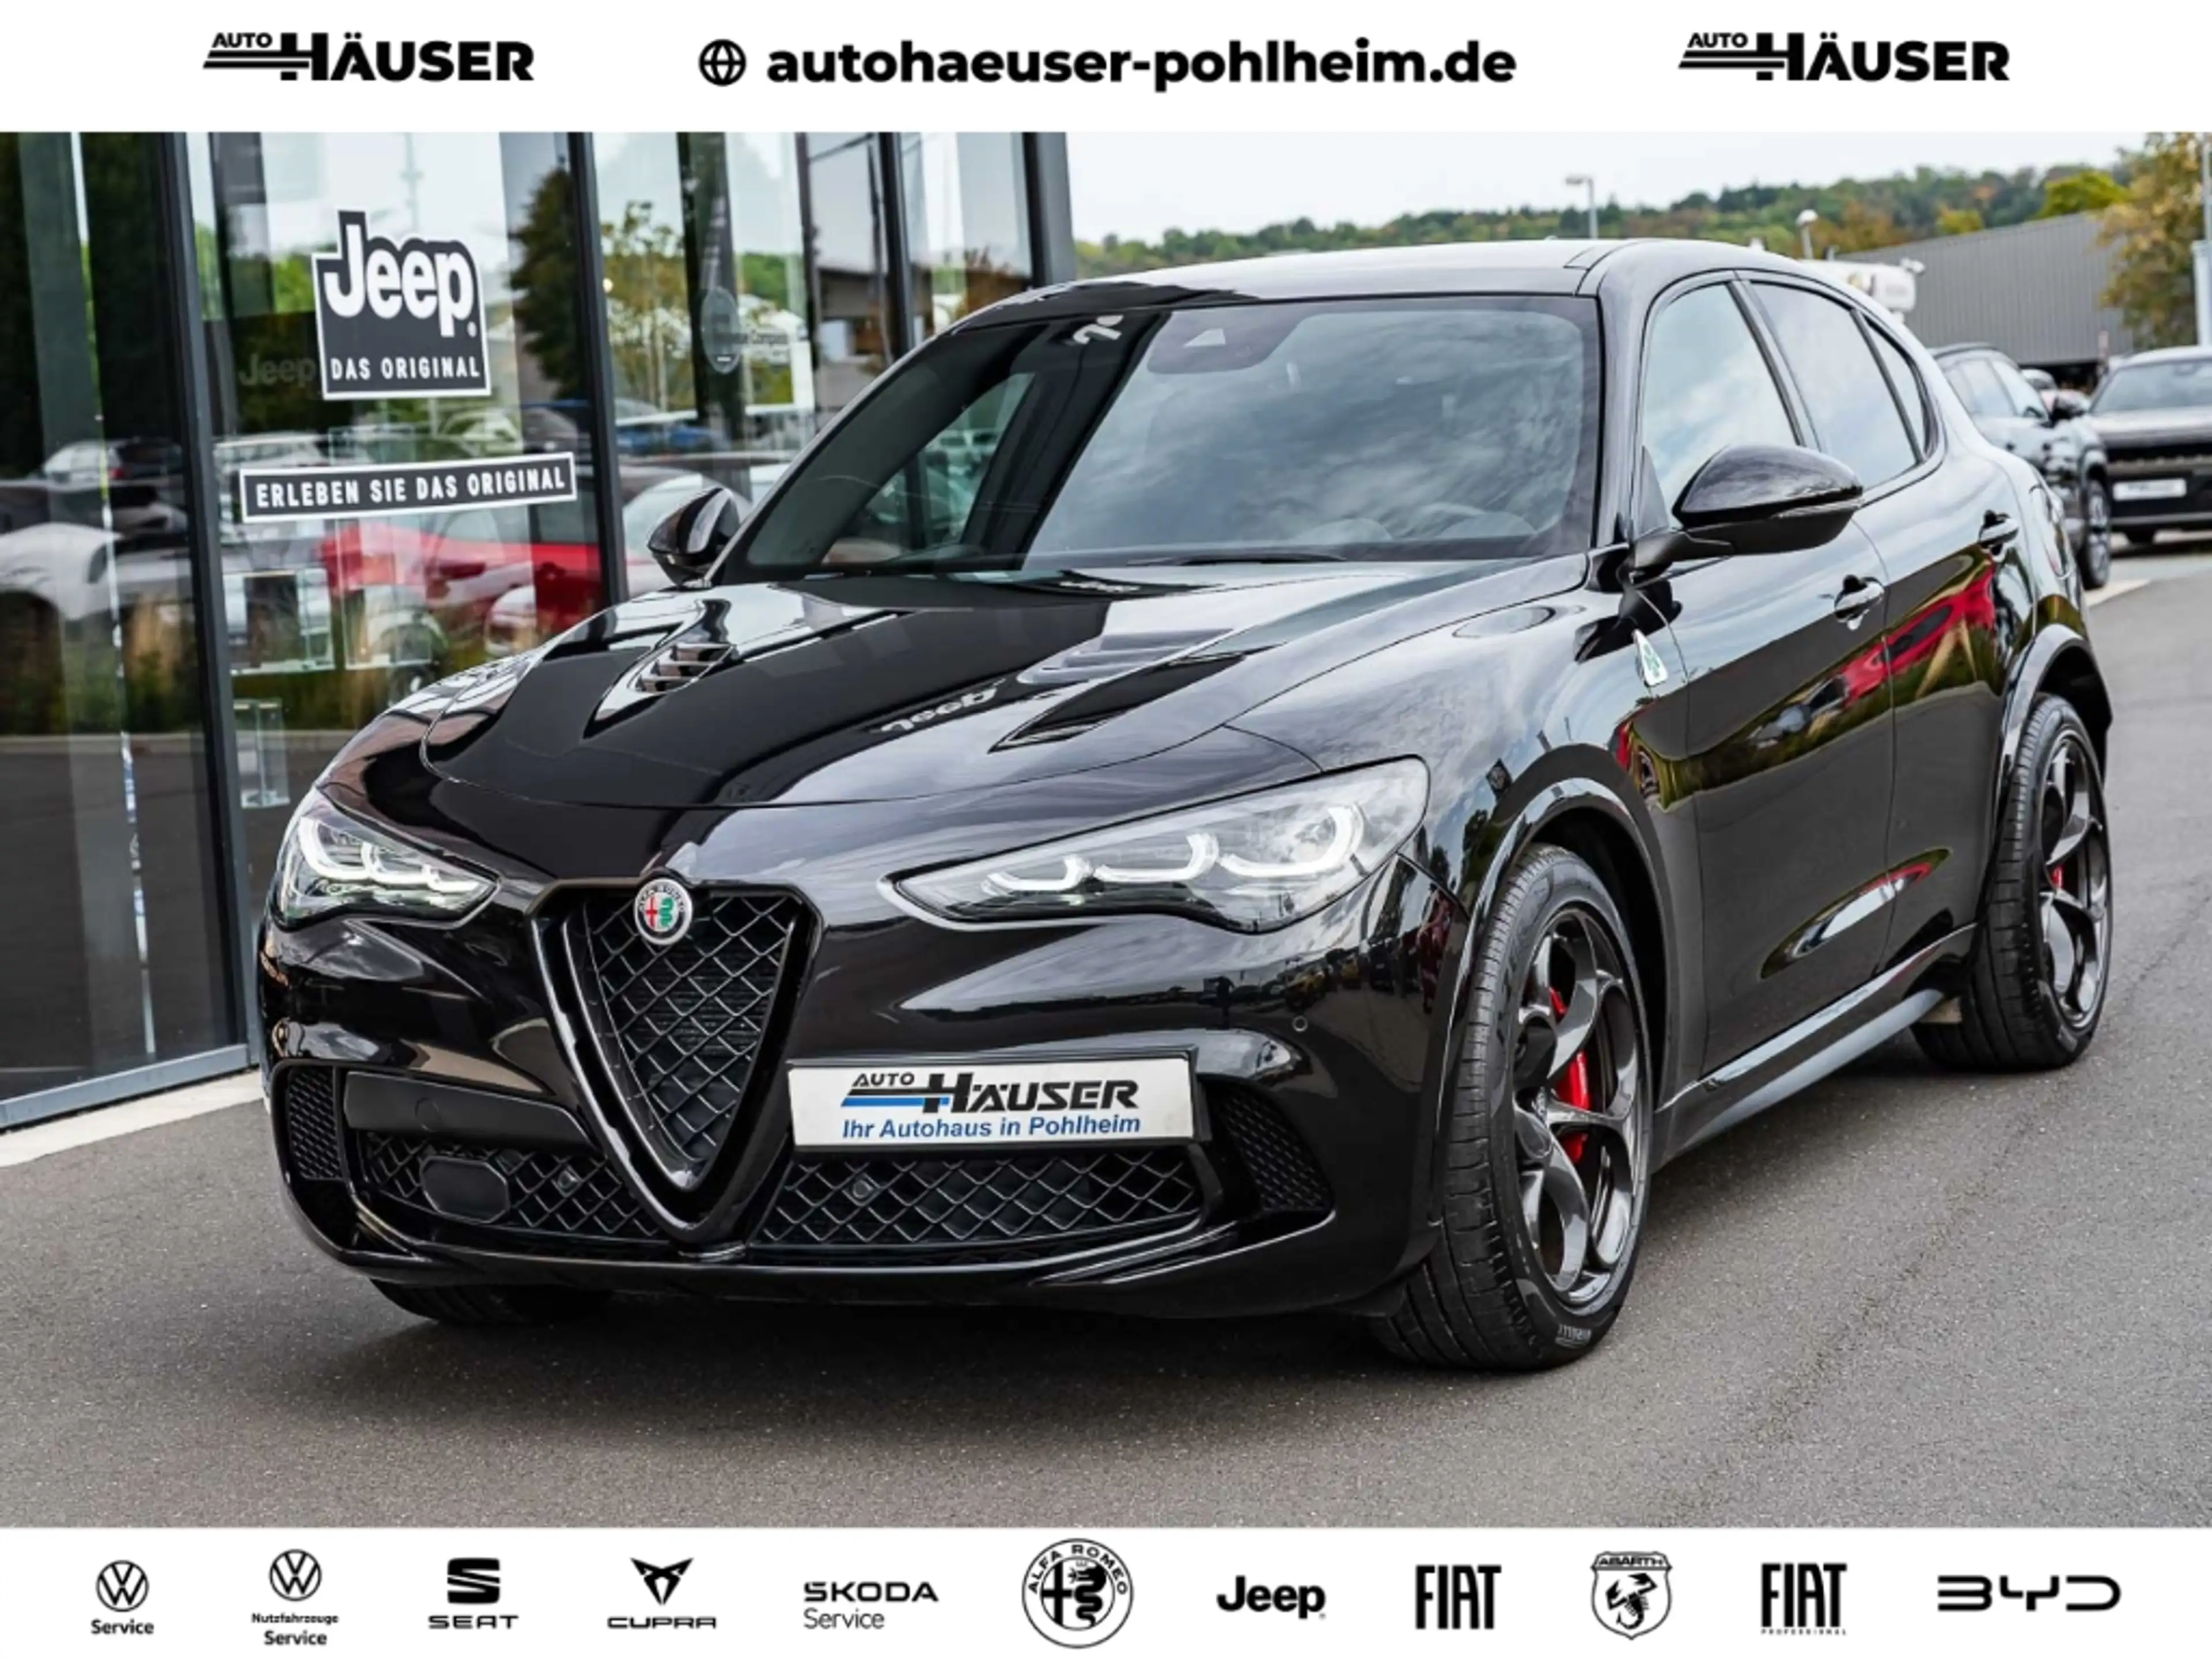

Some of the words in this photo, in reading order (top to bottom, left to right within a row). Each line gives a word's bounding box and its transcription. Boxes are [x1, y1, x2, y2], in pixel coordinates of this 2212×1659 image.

[330, 357, 371, 380] DAS
[380, 355, 480, 379] ORIGINAL
[256, 480, 359, 508] ERLEBEN
[369, 477, 407, 503] SIE
[416, 475, 457, 500] DAS
[467, 467, 565, 497] ORIGINAL
[852, 1072, 915, 1087] AUTO
[842, 1119, 874, 1139] Ihr
[879, 1118, 992, 1138] Autohaus
[1000, 1117, 1021, 1137] in
[1028, 1114, 1141, 1136] Pohlheim
